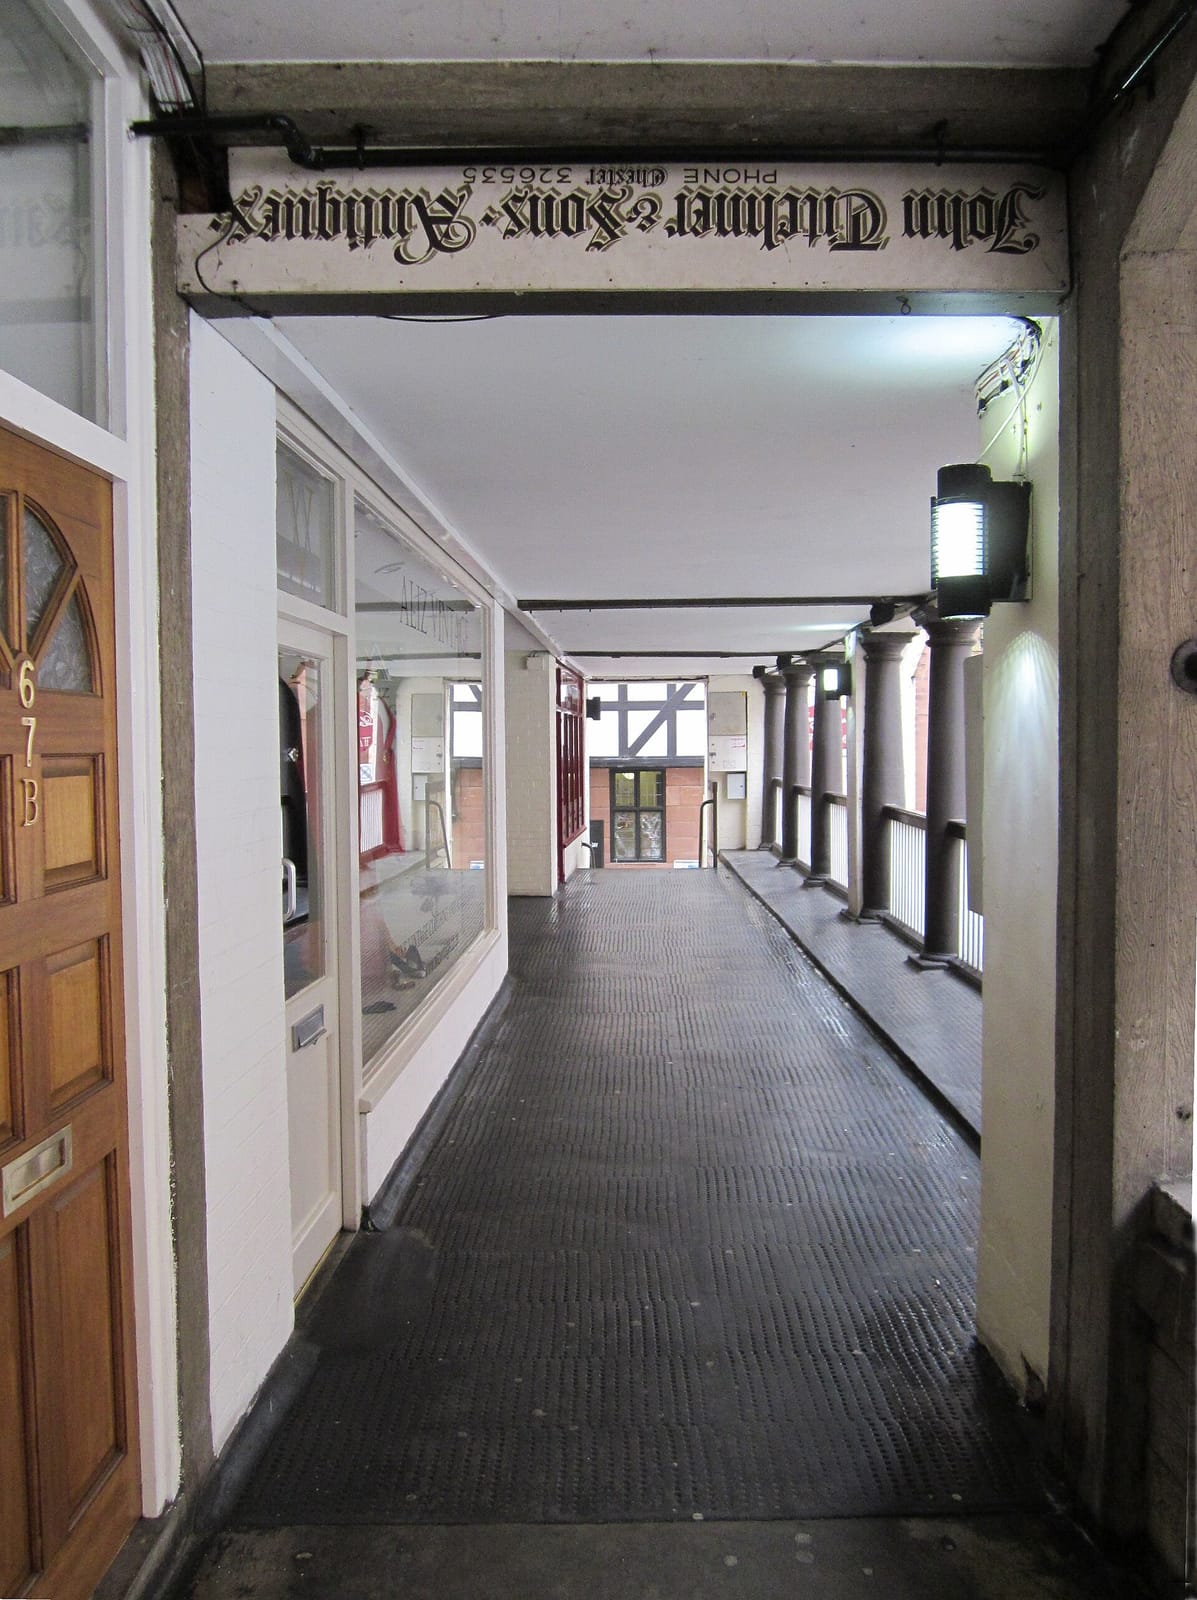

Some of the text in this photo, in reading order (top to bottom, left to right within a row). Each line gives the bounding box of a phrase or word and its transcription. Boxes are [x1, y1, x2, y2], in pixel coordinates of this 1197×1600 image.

[463, 165, 778, 188] PHONE Chester 326535
[901, 182, 1046, 255] John
